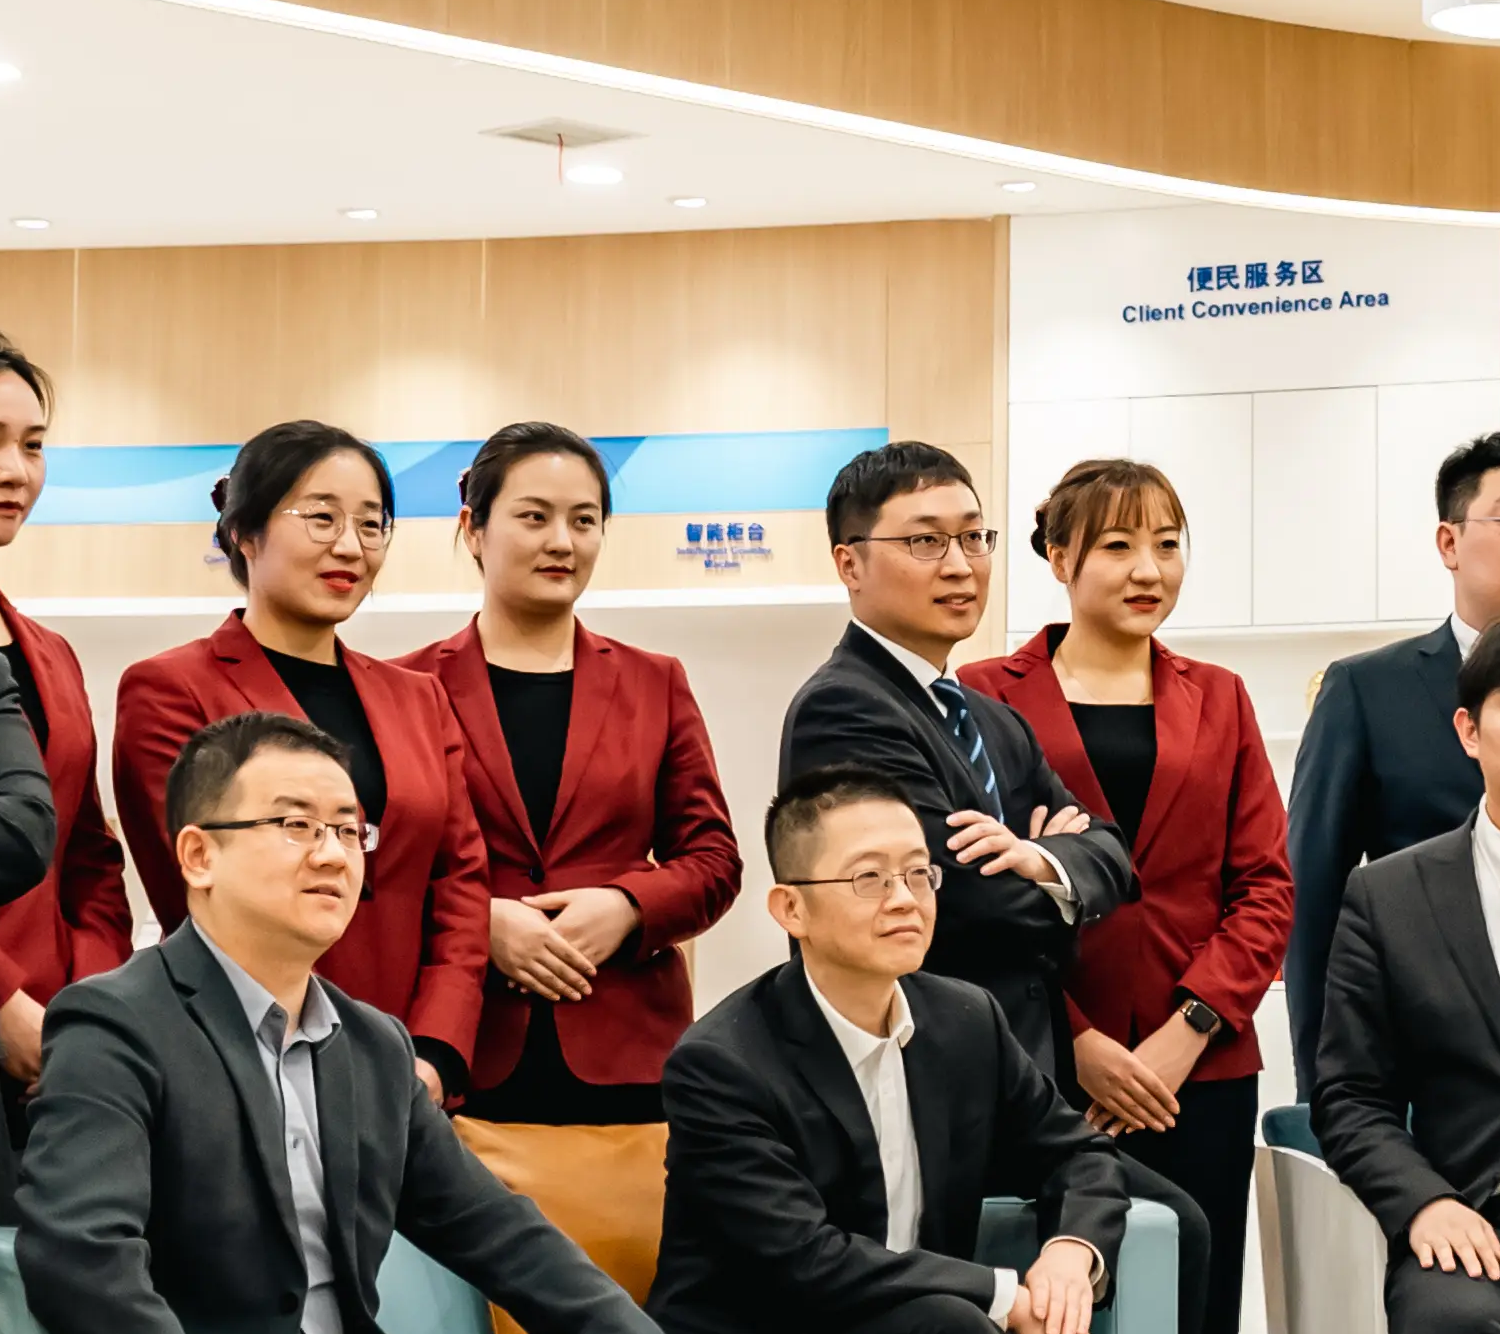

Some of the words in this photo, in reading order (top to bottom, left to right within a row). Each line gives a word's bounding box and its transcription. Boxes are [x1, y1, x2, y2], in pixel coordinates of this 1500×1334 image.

[1187, 260, 1324, 292] 便民服务区
[1122, 304, 1185, 323] Client
[1191, 295, 1332, 318] Convenience
[1339, 291, 1389, 309] Area
